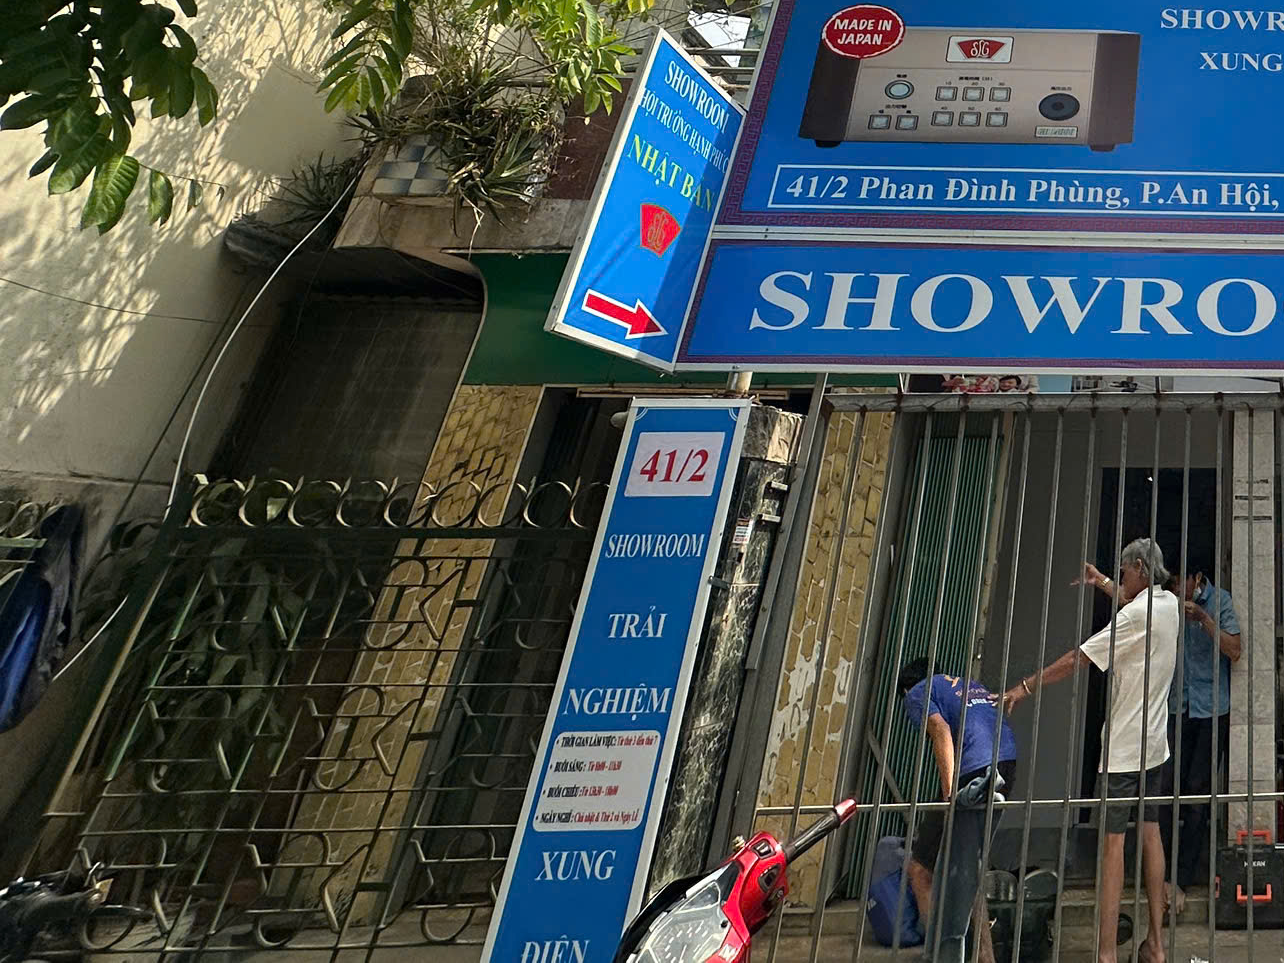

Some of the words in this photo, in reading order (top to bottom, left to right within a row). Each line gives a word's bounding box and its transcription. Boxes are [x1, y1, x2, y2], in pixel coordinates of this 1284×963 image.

[834, 18, 874, 31] MADE
[878, 19, 893, 31] IN
[837, 33, 883, 45] JAPAN
[1199, 52, 1283, 72] XUNG
[664, 60, 730, 134] SHOWROOM
[627, 133, 682, 186] NHẬT
[688, 128, 712, 161] HẠNH
[786, 175, 847, 199] 41/2
[859, 177, 934, 201] Phan
[944, 178, 1016, 202] Đình
[1026, 178, 1131, 209] Phùng,
[1140, 181, 1209, 206] P.An
[1219, 182, 1279, 212] Hội,
[640, 448, 709, 484] 41/2
[604, 532, 706, 559] SHOWROOM
[607, 605, 668, 640] TRẢI
[562, 687, 672, 722] NGHIỆM
[535, 850, 617, 881] XUNG
